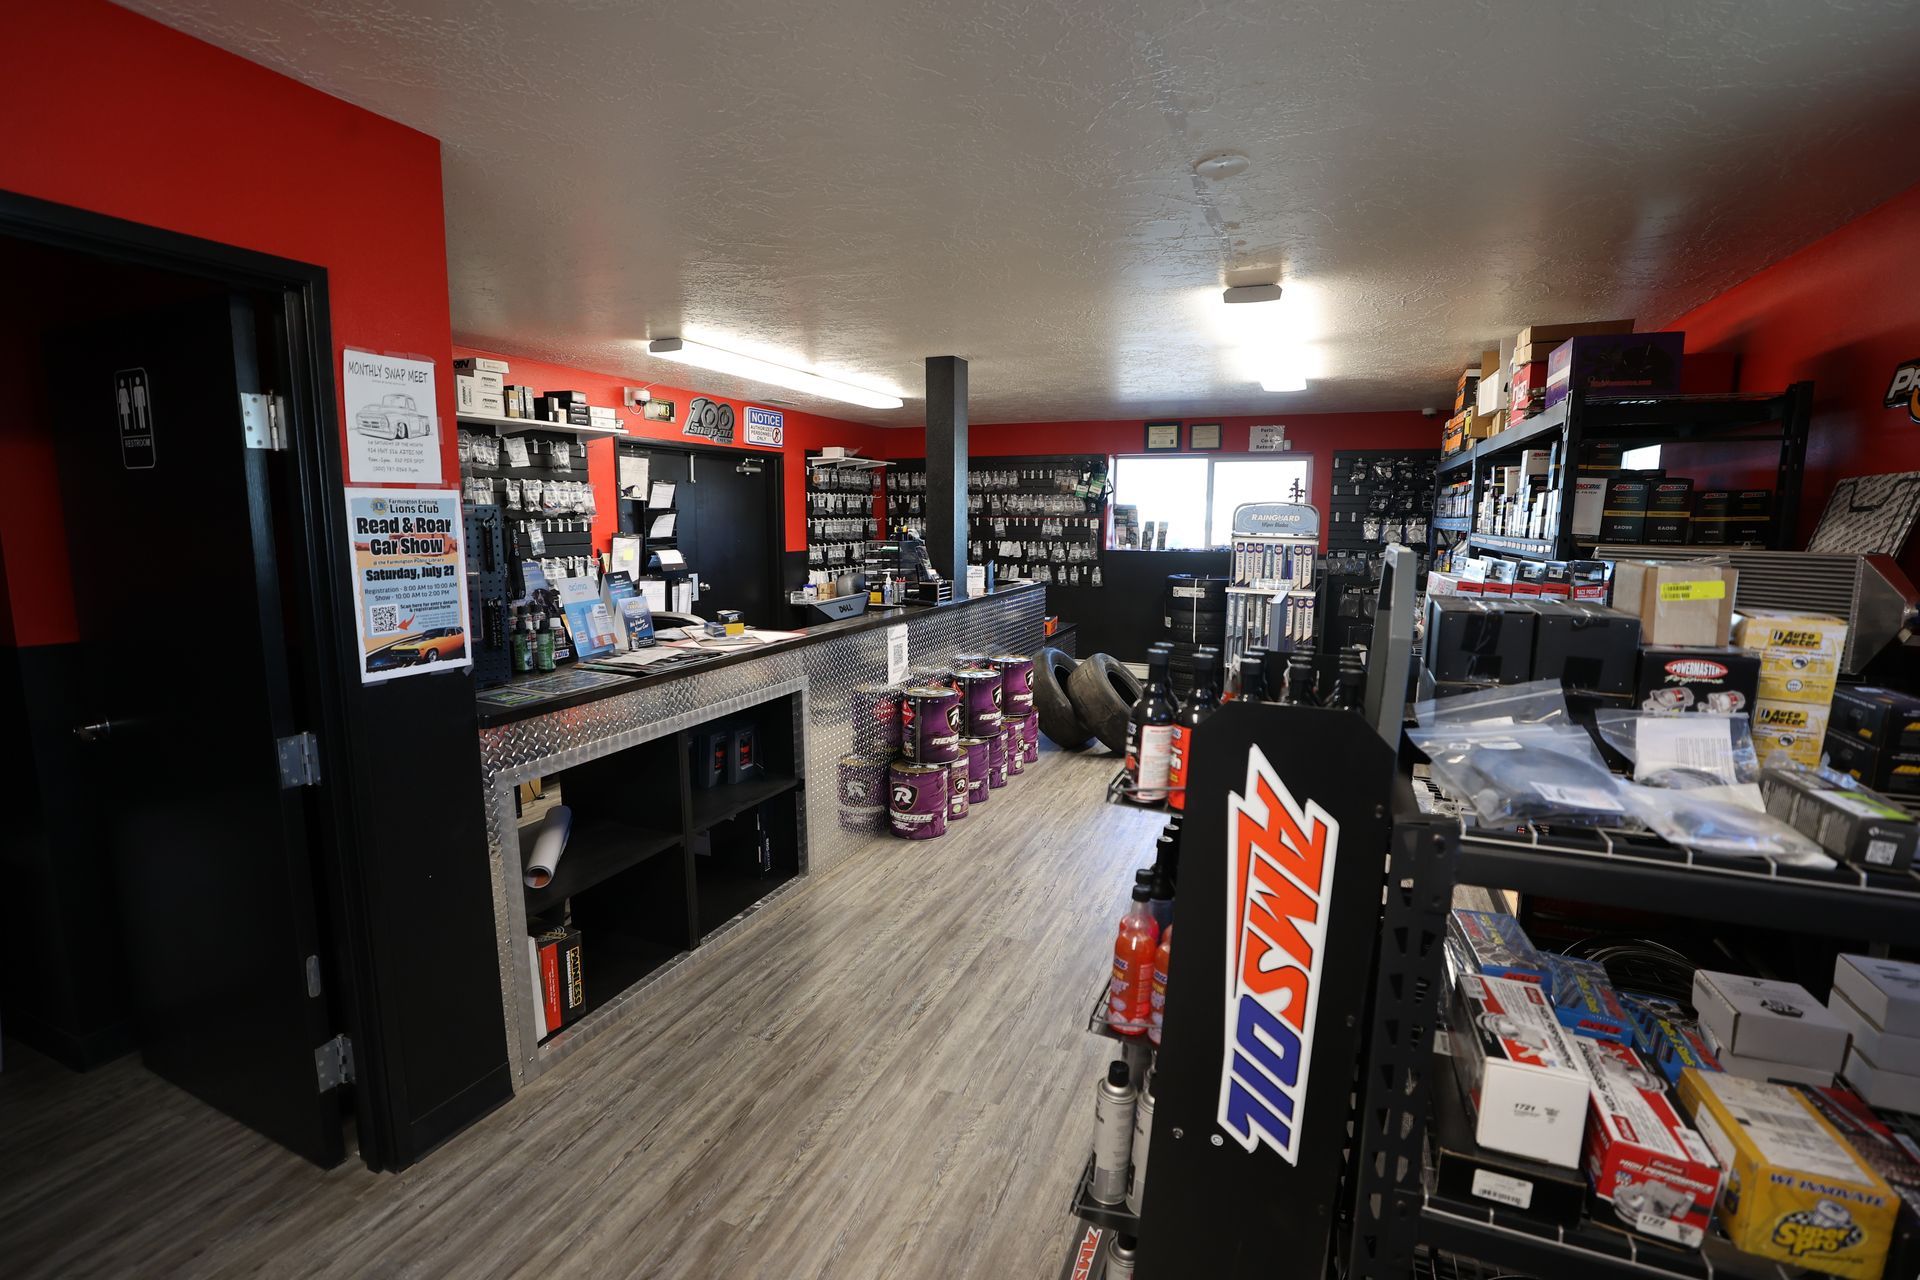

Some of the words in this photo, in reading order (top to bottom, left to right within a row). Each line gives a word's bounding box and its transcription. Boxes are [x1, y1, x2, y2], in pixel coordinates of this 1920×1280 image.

[349, 361, 382, 378] MONTHLY
[384, 367, 406, 380] SWAP
[407, 370, 428, 383] MEET
[687, 398, 734, 431] 100
[751, 412, 781, 425] NOTICE
[689, 422, 732, 438] Snap-on
[390, 505, 415, 513] Lions
[418, 504, 439, 513] Club
[1252, 513, 1300, 522] RAINGUARD
[357, 517, 399, 534] Read
[402, 517, 413, 533] &
[416, 517, 451, 533] Roar
[371, 539, 397, 555] Car
[400, 538, 443, 554] Show
[366, 568, 420, 581] Saturday,
[422, 565, 441, 578] July
[364, 587, 399, 595] Registration
[838, 604, 853, 613] DELL
[1786, 631, 1815, 640] Auto
[1781, 639, 1820, 647] Meter
[1672, 662, 1720, 676] POWERMASTER
[1772, 709, 1801, 719] Auto
[1768, 717, 1805, 726] Meter
[894, 787, 912, 804] R
[1114, 958, 1127, 970] OIL
[1227, 770, 1328, 1151] AMSOIL
[570, 946, 582, 1006] PAINLESS
[1153, 970, 1168, 984] OIL
[1515, 1103, 1536, 1111] 1721
[1618, 1158, 1643, 1171] HIGH
[1643, 1167, 1714, 1195] PERFORMANCE
[1770, 1174, 1794, 1186] WE
[1800, 1180, 1884, 1207] INNOVATE
[1641, 1214, 1666, 1227] 1722
[1775, 1222, 1848, 1245] Super
[1791, 1235, 1841, 1256] Pro
